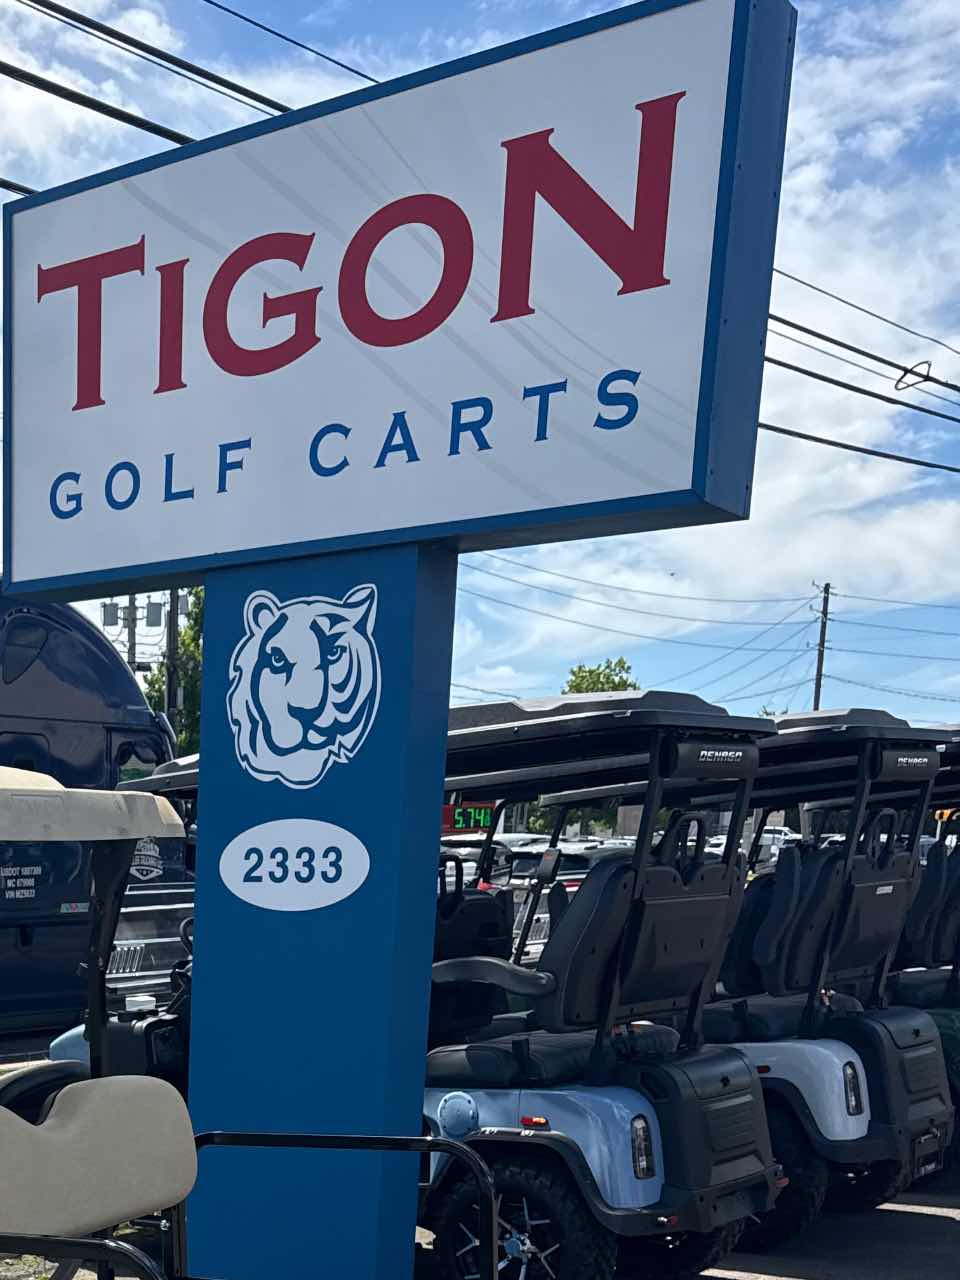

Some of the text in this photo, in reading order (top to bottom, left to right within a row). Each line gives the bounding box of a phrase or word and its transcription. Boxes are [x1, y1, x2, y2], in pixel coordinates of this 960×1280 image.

[38, 92, 683, 409] TIGON
[49, 369, 641, 519] GOLF CARTS
[242, 846, 343, 884] 2333
